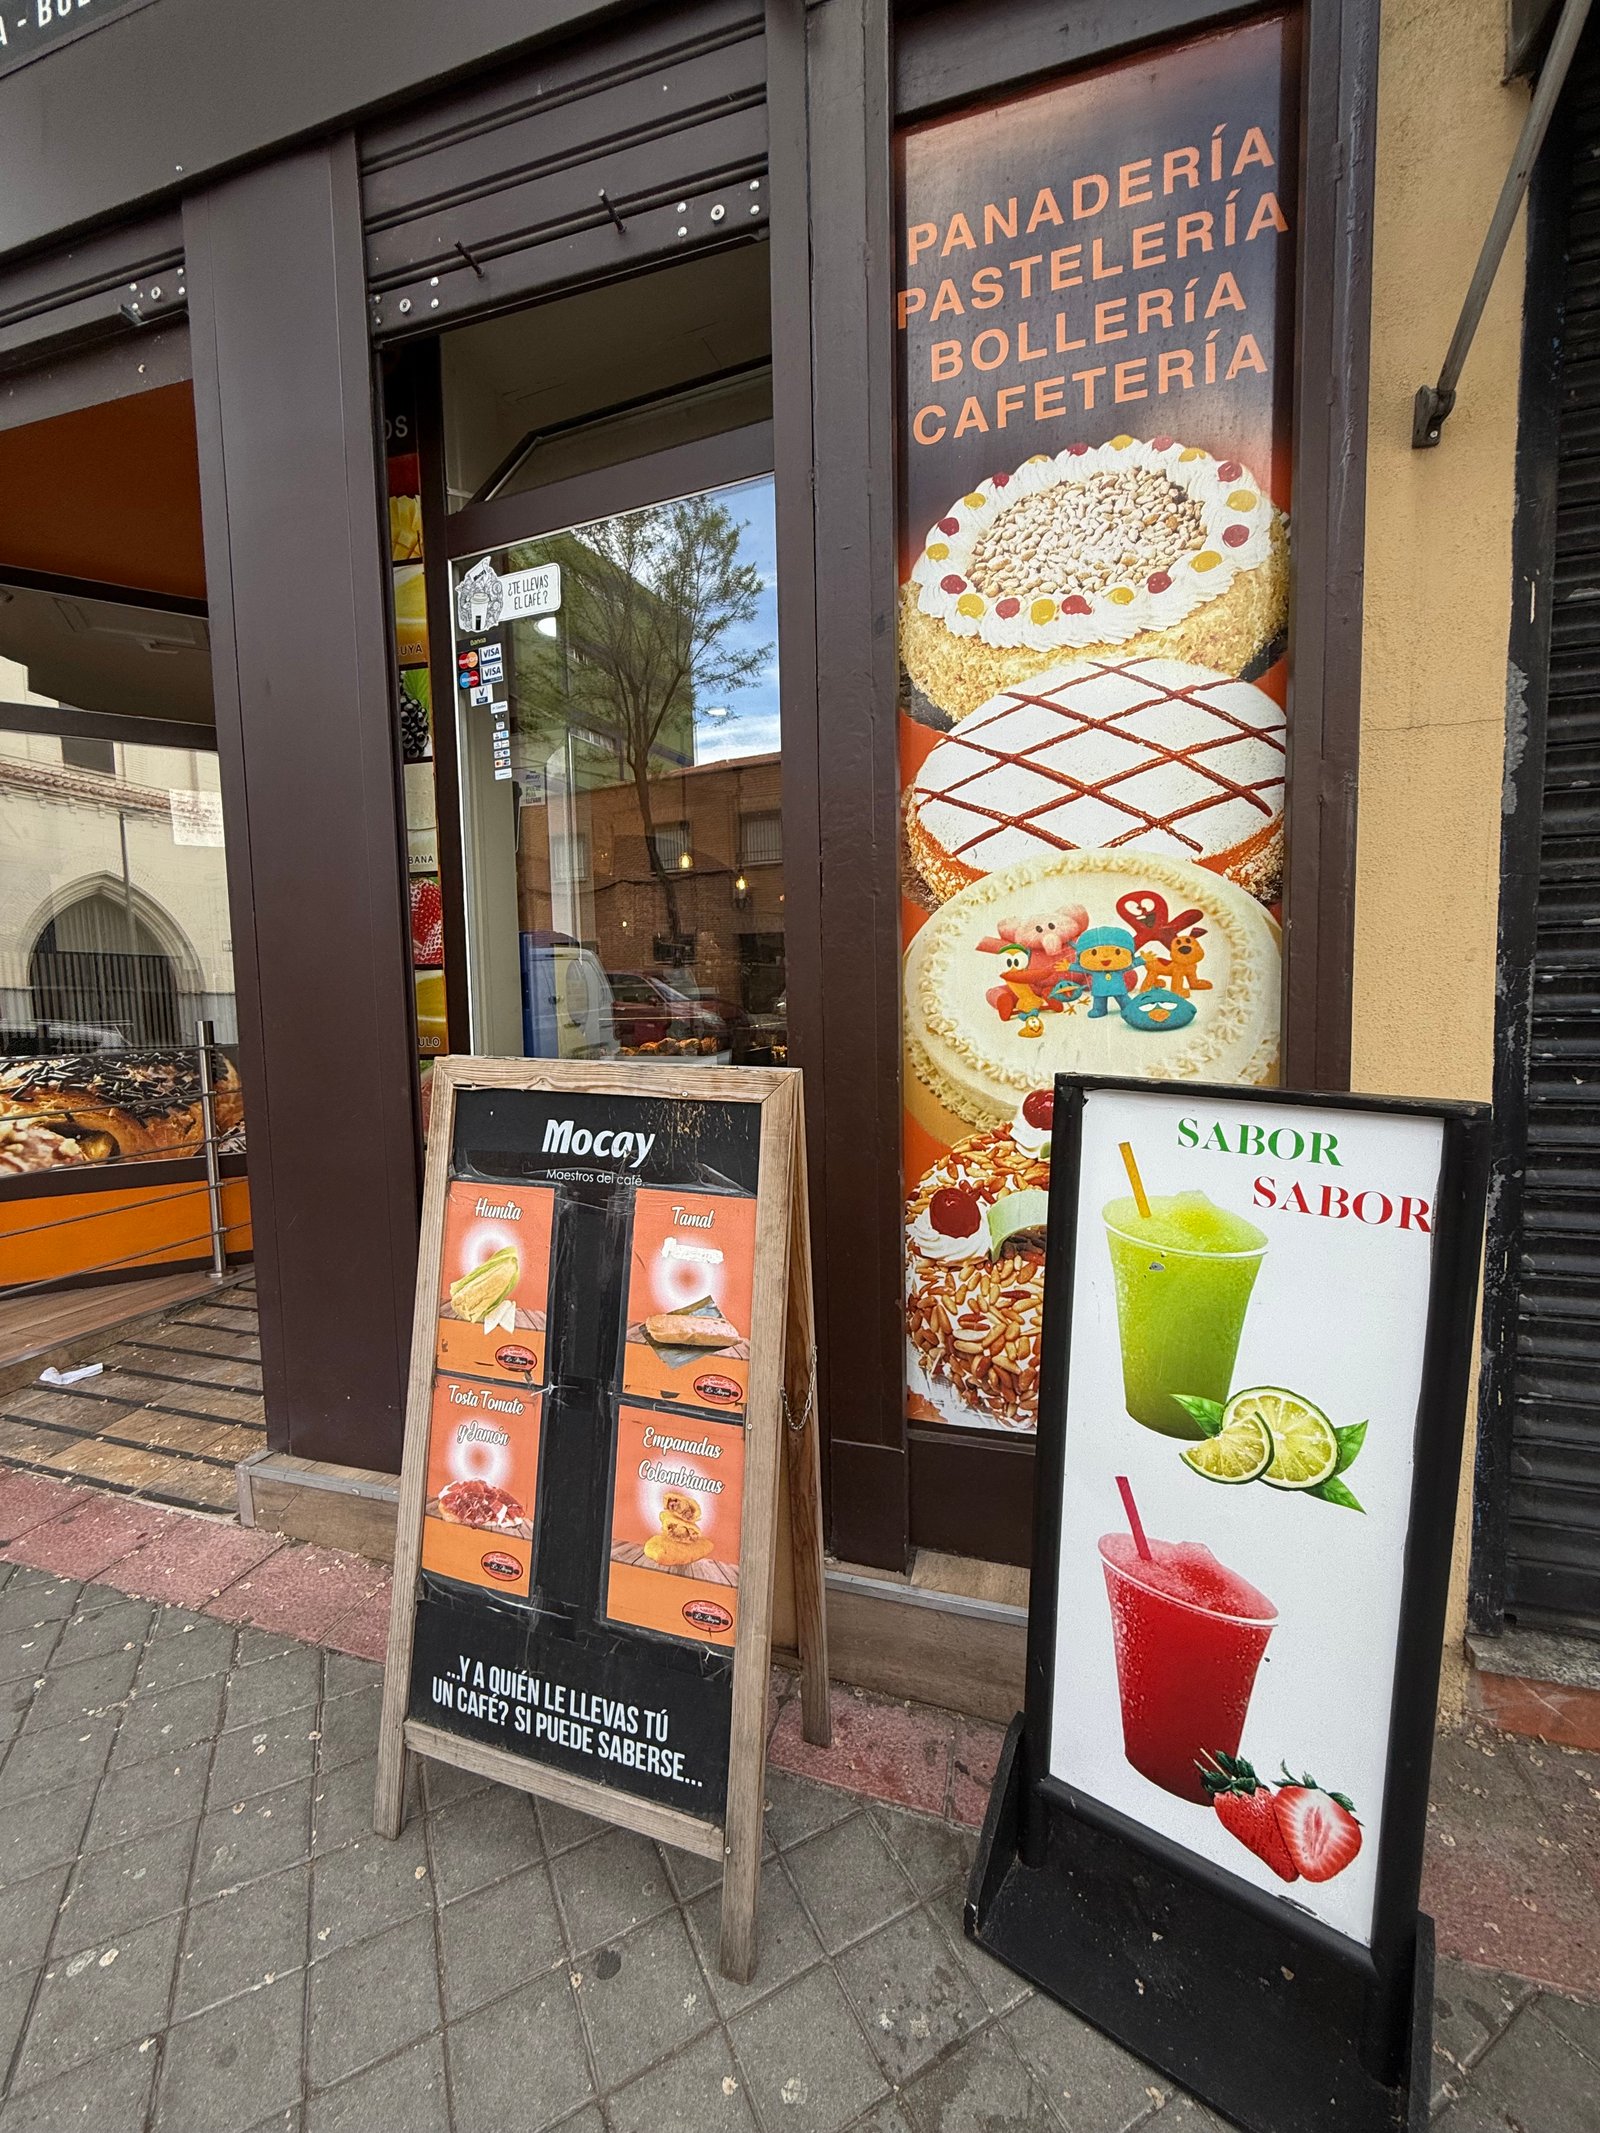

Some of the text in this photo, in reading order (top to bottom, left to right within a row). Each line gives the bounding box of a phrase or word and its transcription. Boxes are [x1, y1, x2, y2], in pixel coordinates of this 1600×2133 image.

[907, 122, 1275, 266] PANADERÍA
[897, 188, 1289, 329] PASTELERÍA
[912, 329, 1268, 446] CAFETERÍA
[507, 574, 549, 597] ¿TE LLEVAS
[514, 597, 523, 611] EL
[524, 591, 541, 608] CAFÉ
[483, 647, 500, 658] VISA
[484, 666, 502, 677] VISA
[541, 1119, 655, 1168] Mocay
[1177, 1117, 1344, 1167] SABOR
[546, 1169, 594, 1184] Maestros
[596, 1171, 614, 1185] del
[474, 1196, 523, 1221] Humita
[671, 1206, 715, 1229] Tamal
[1253, 1175, 1432, 1234] SABOR
[448, 1384, 525, 1416] Tosta Tomate
[466, 1420, 510, 1447] Jamón
[642, 1426, 724, 1460] Empanadas
[638, 1459, 725, 1495] Colombianas
[473, 1661, 485, 1690] A
[488, 1665, 540, 1707] QUIÉN
[544, 1682, 567, 1714] LE
[569, 1689, 640, 1735] LLEVAS
[643, 1708, 669, 1743] TÚ
[432, 1676, 703, 1787] UN CAFÉ? SI PUEDE SABERSE...
